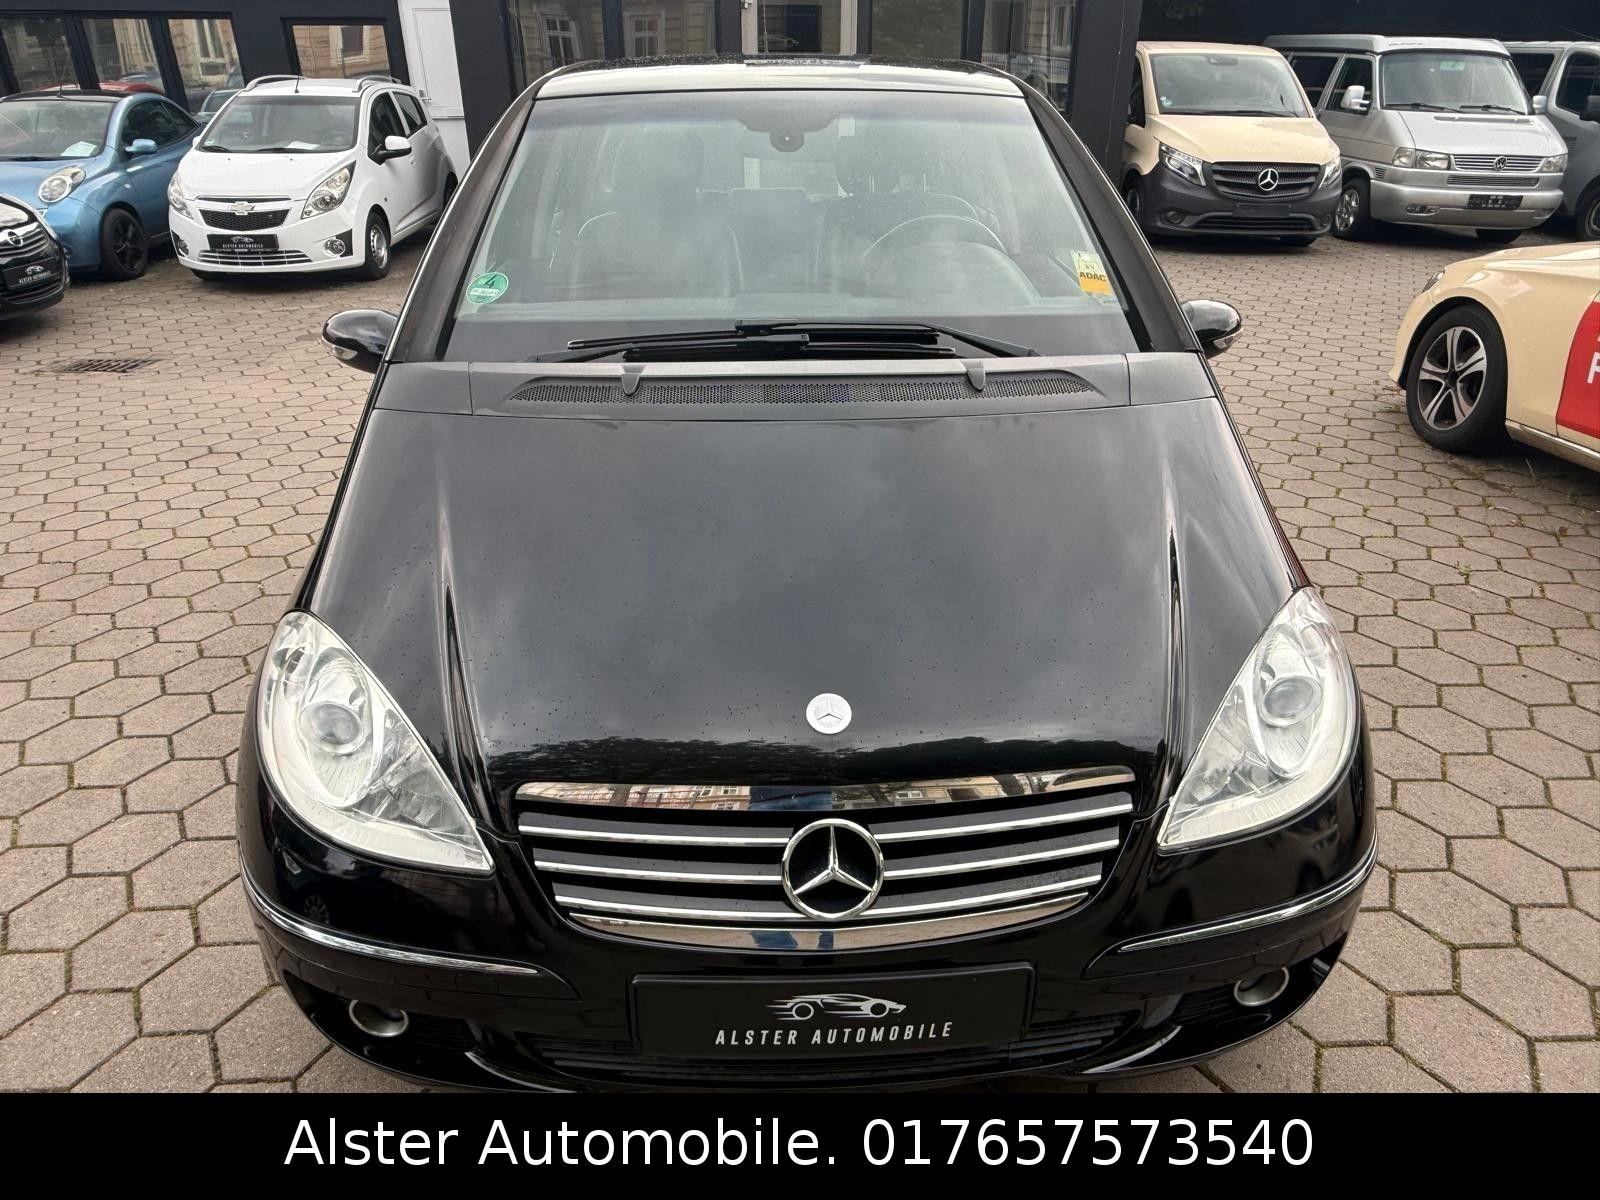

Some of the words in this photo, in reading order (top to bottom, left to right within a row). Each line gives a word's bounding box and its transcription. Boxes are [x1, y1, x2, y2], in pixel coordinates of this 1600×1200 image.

[483, 274, 498, 289] 4
[1079, 271, 1107, 282] ADAC
[715, 1029, 798, 1046] ALSTER
[811, 1021, 954, 1045] AUTOMOBILE
